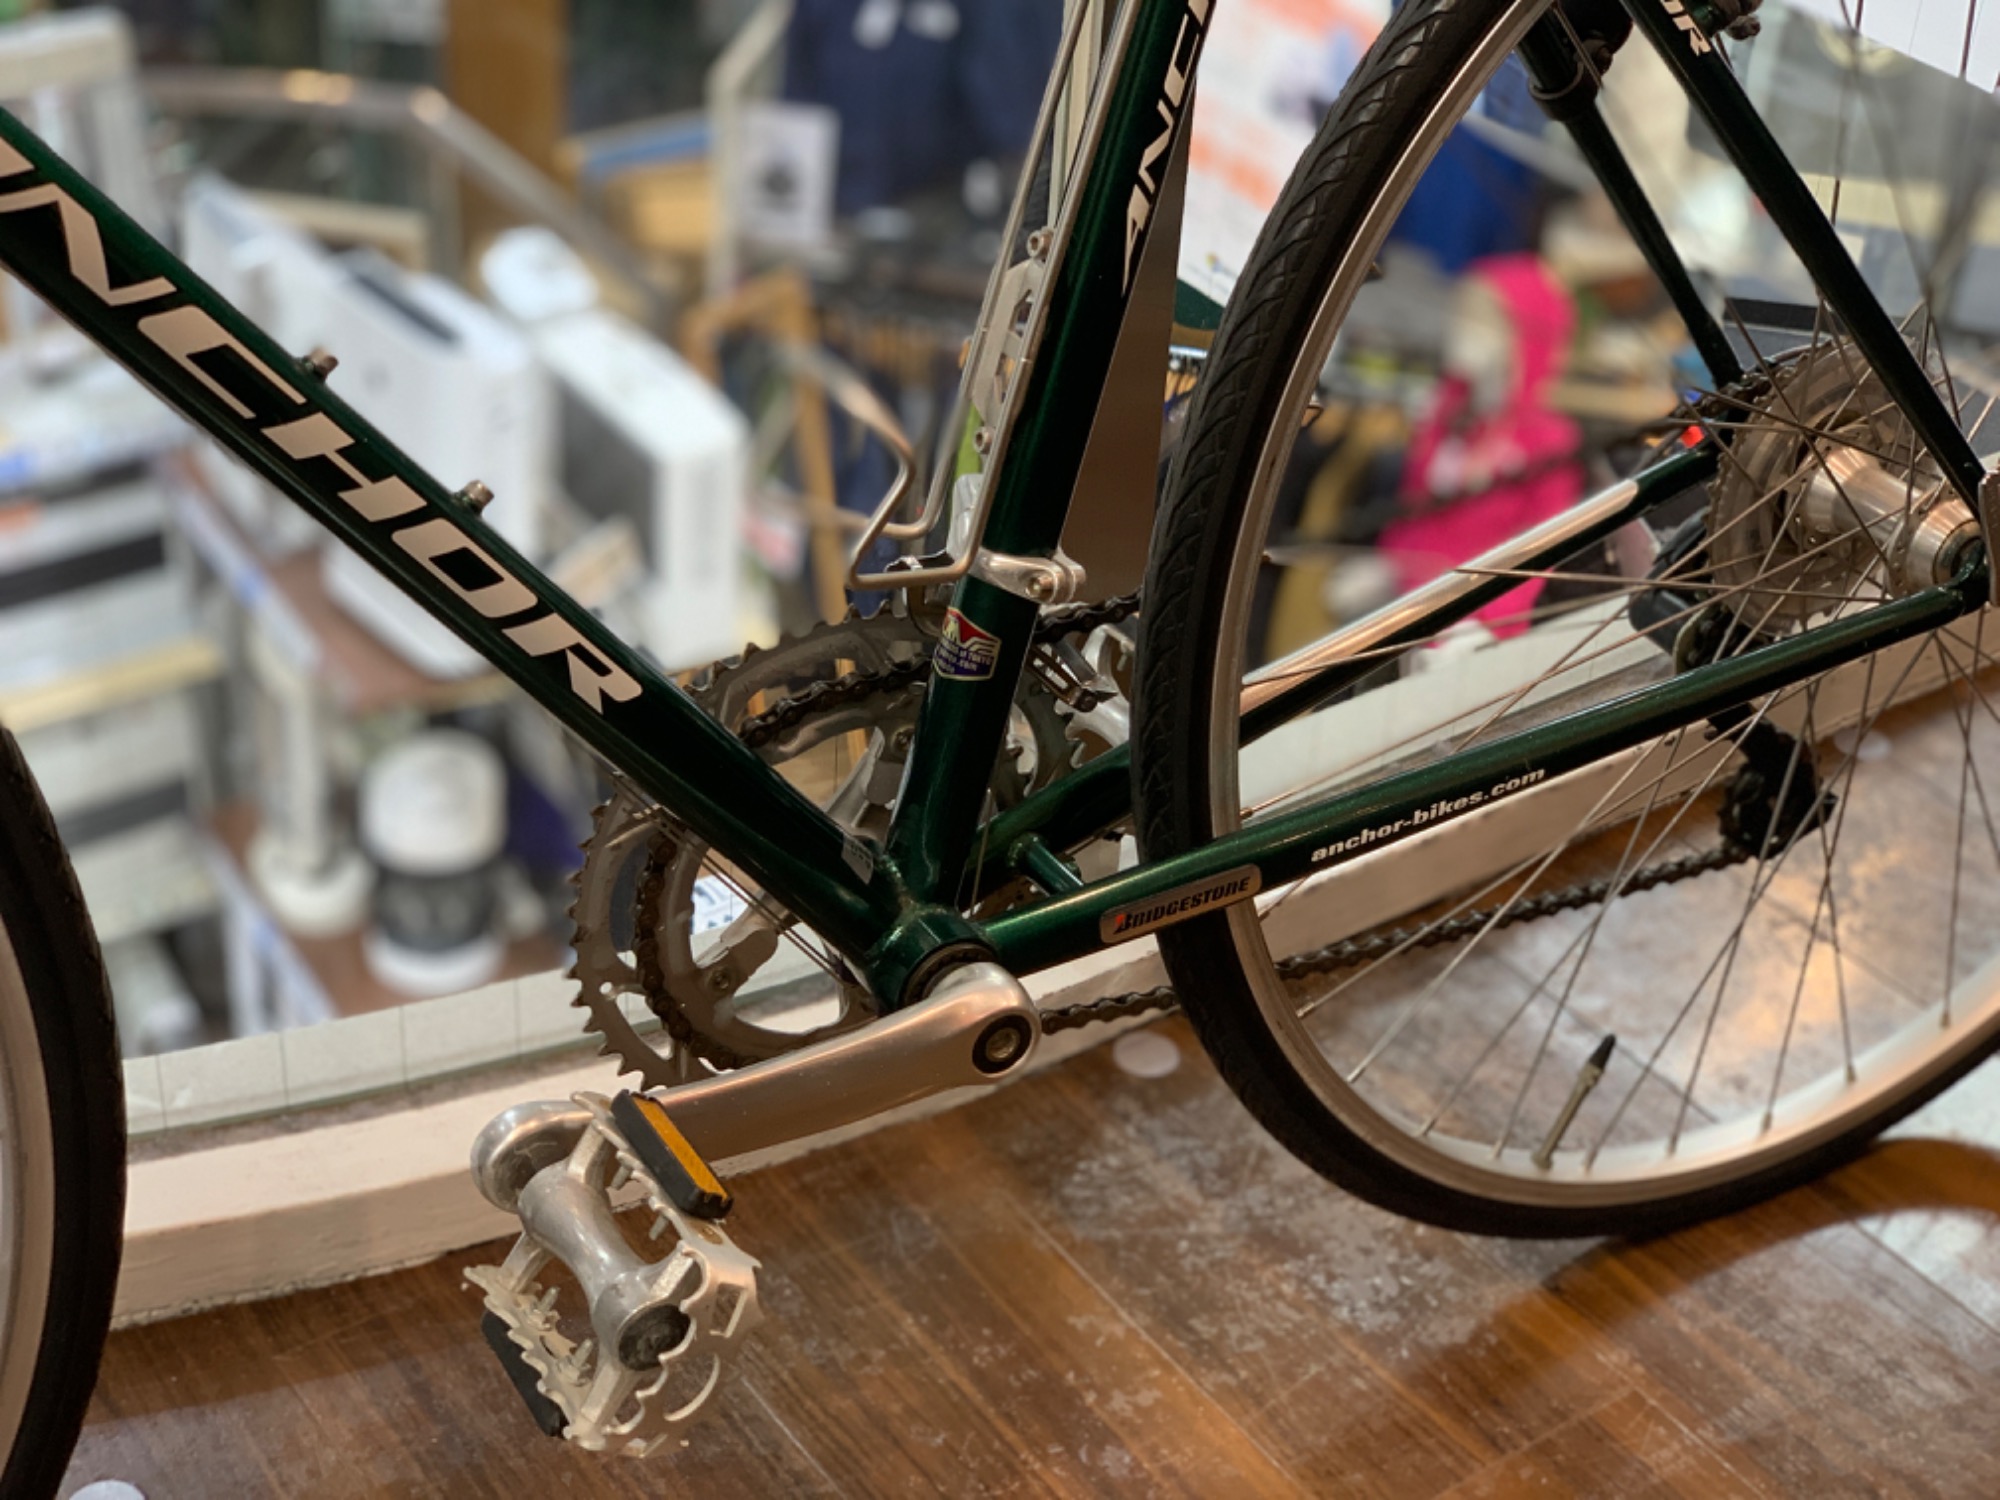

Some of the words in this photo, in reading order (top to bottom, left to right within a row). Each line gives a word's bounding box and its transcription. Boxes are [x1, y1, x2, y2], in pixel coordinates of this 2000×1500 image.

[0, 135, 643, 714] NCHOR
[1310, 768, 1546, 863] anchor-bikes.com
[1112, 876, 1251, 935] BRIDGESTONE
